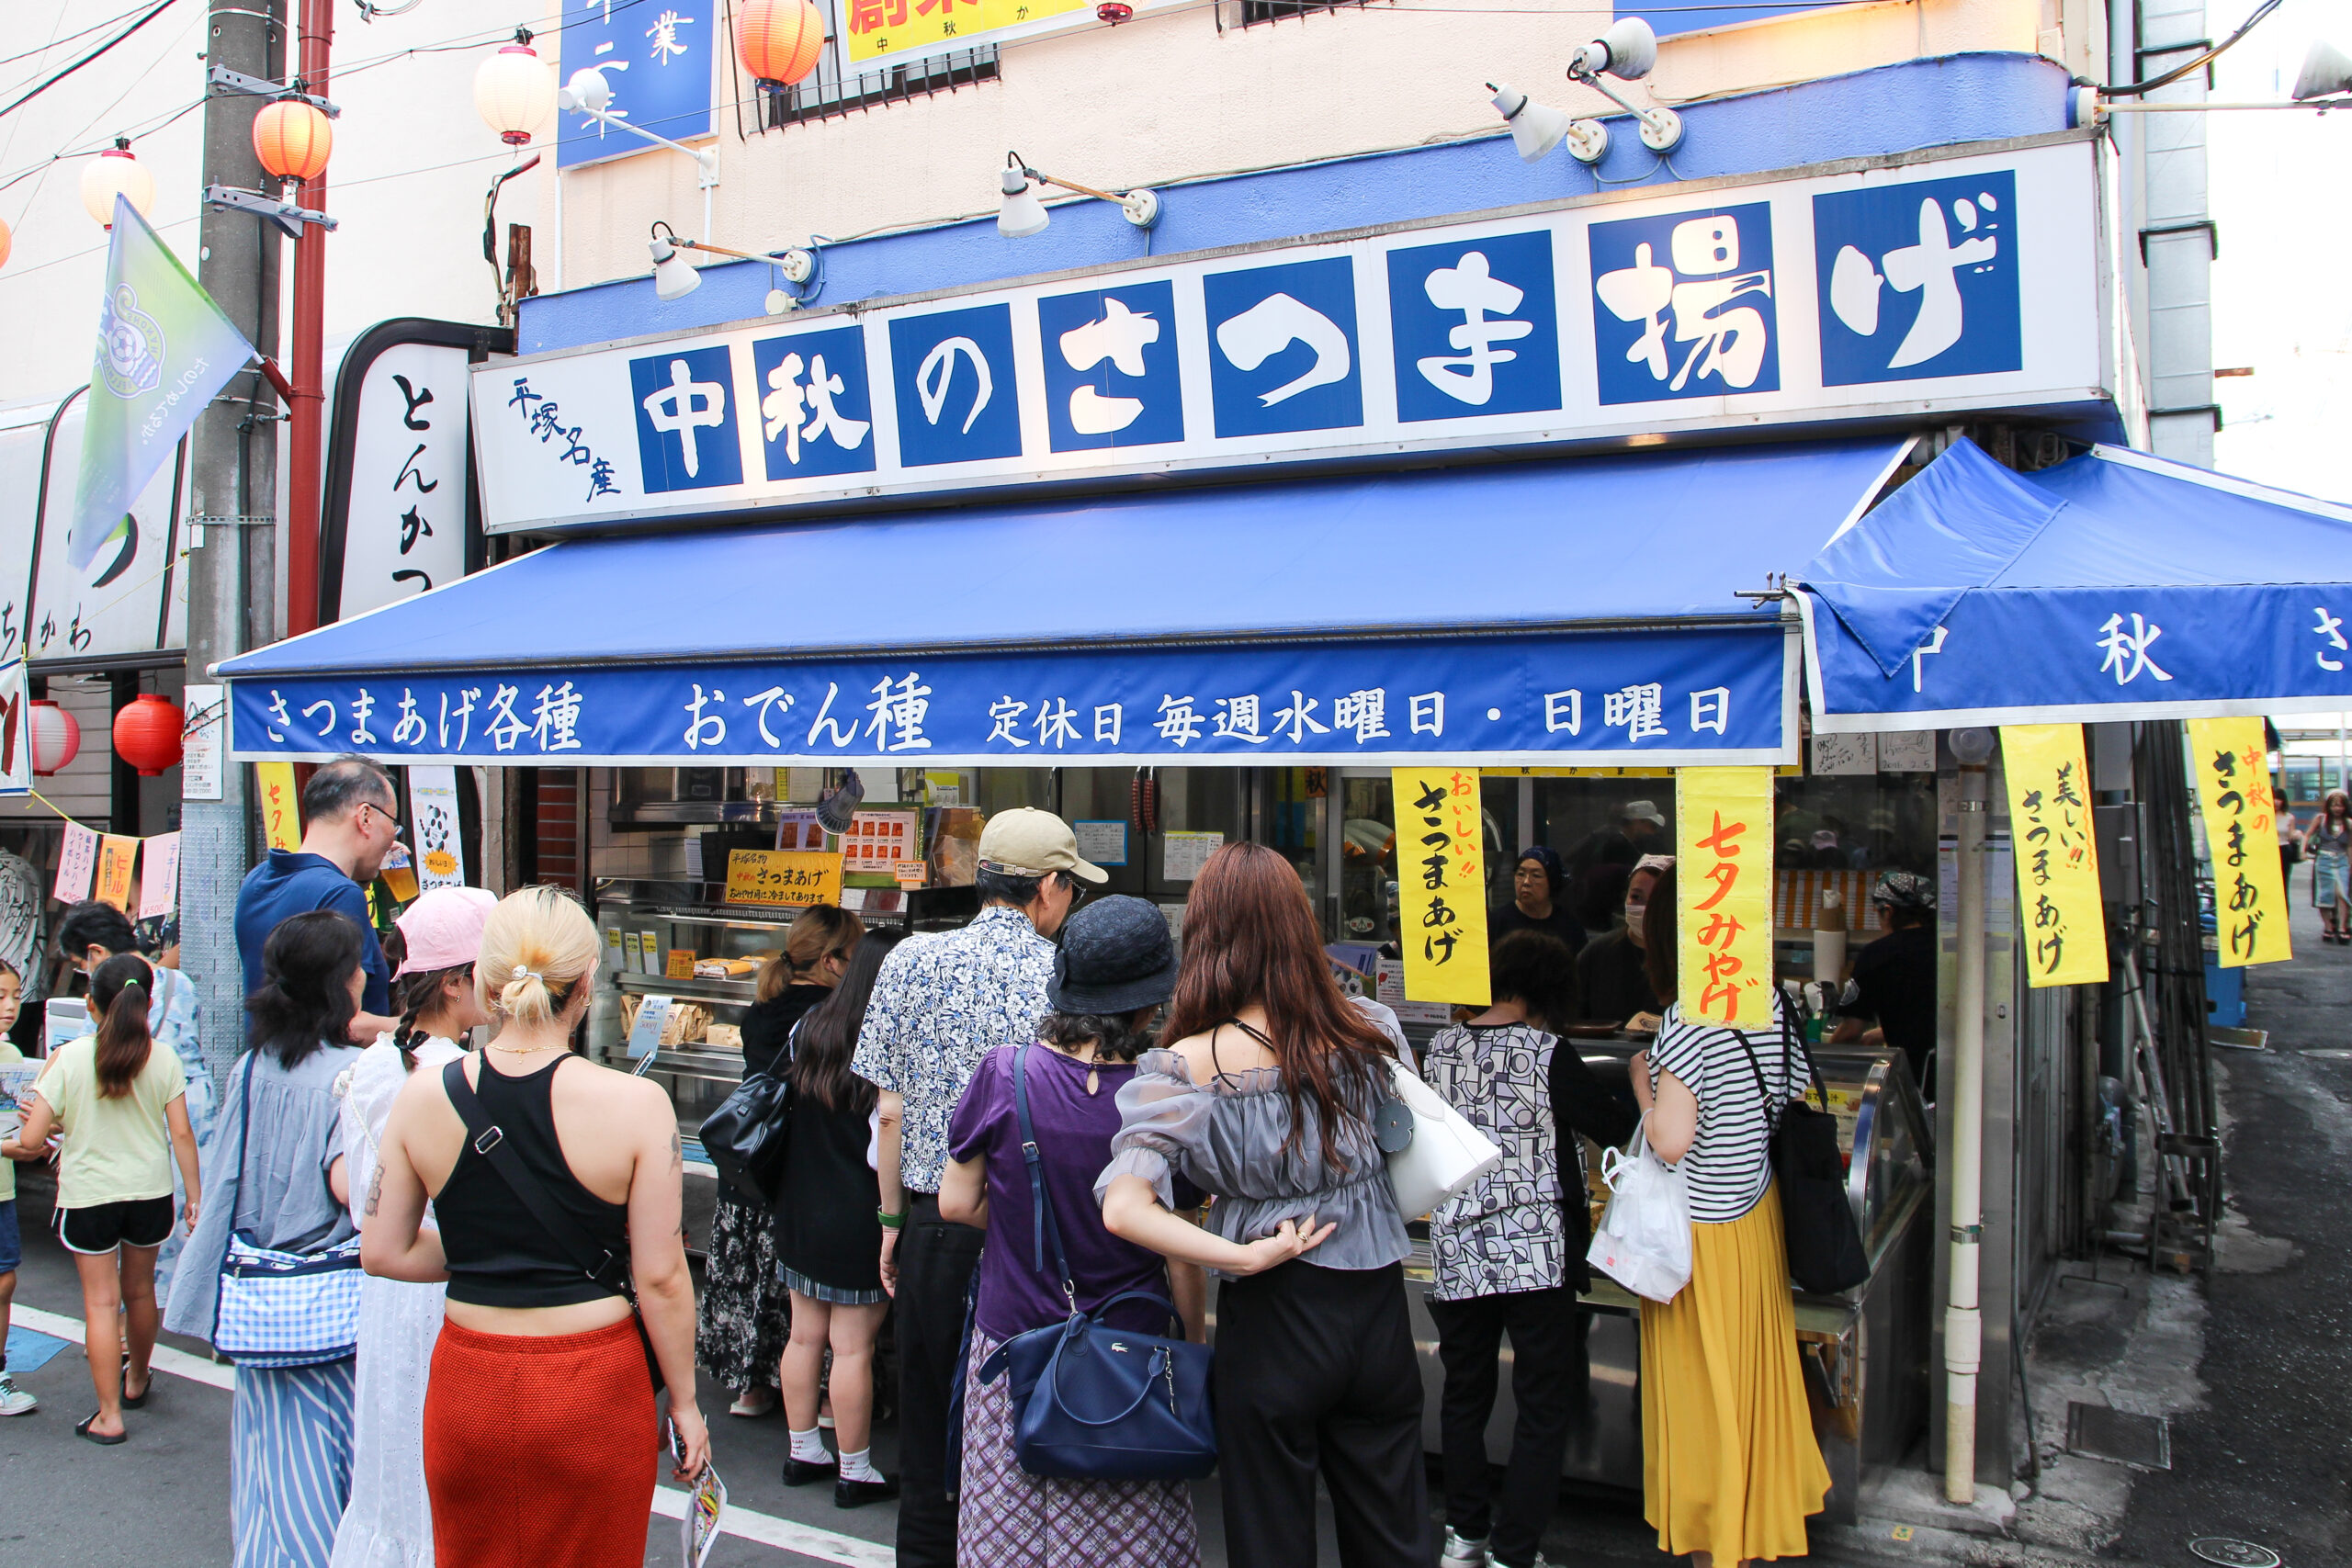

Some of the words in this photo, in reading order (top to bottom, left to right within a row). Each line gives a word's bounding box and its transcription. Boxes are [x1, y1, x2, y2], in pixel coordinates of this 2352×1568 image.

[643, 191, 1998, 479] 中秋のさつま揚げ
[391, 374, 438, 593] とんかつ
[508, 377, 622, 502] 平塚名産
[268, 681, 583, 751] さつまあげ各種
[684, 671, 933, 752] おでん種
[986, 695, 1123, 749] 定休日
[2241, 745, 2273, 835] 中秋の
[110, 854, 130, 895] ビール
[164, 843, 178, 895] テキーラ
[756, 866, 830, 887] さつまあげ
[1413, 779, 1464, 966] さつまあげ
[2022, 788, 2067, 976] さつまあげ
[2212, 749, 2265, 961] さつまあげ
[143, 903, 164, 915] ¥500
[1693, 809, 1759, 1024] 七夕みやげ
[1804, 1090, 1840, 1103] おで汁
